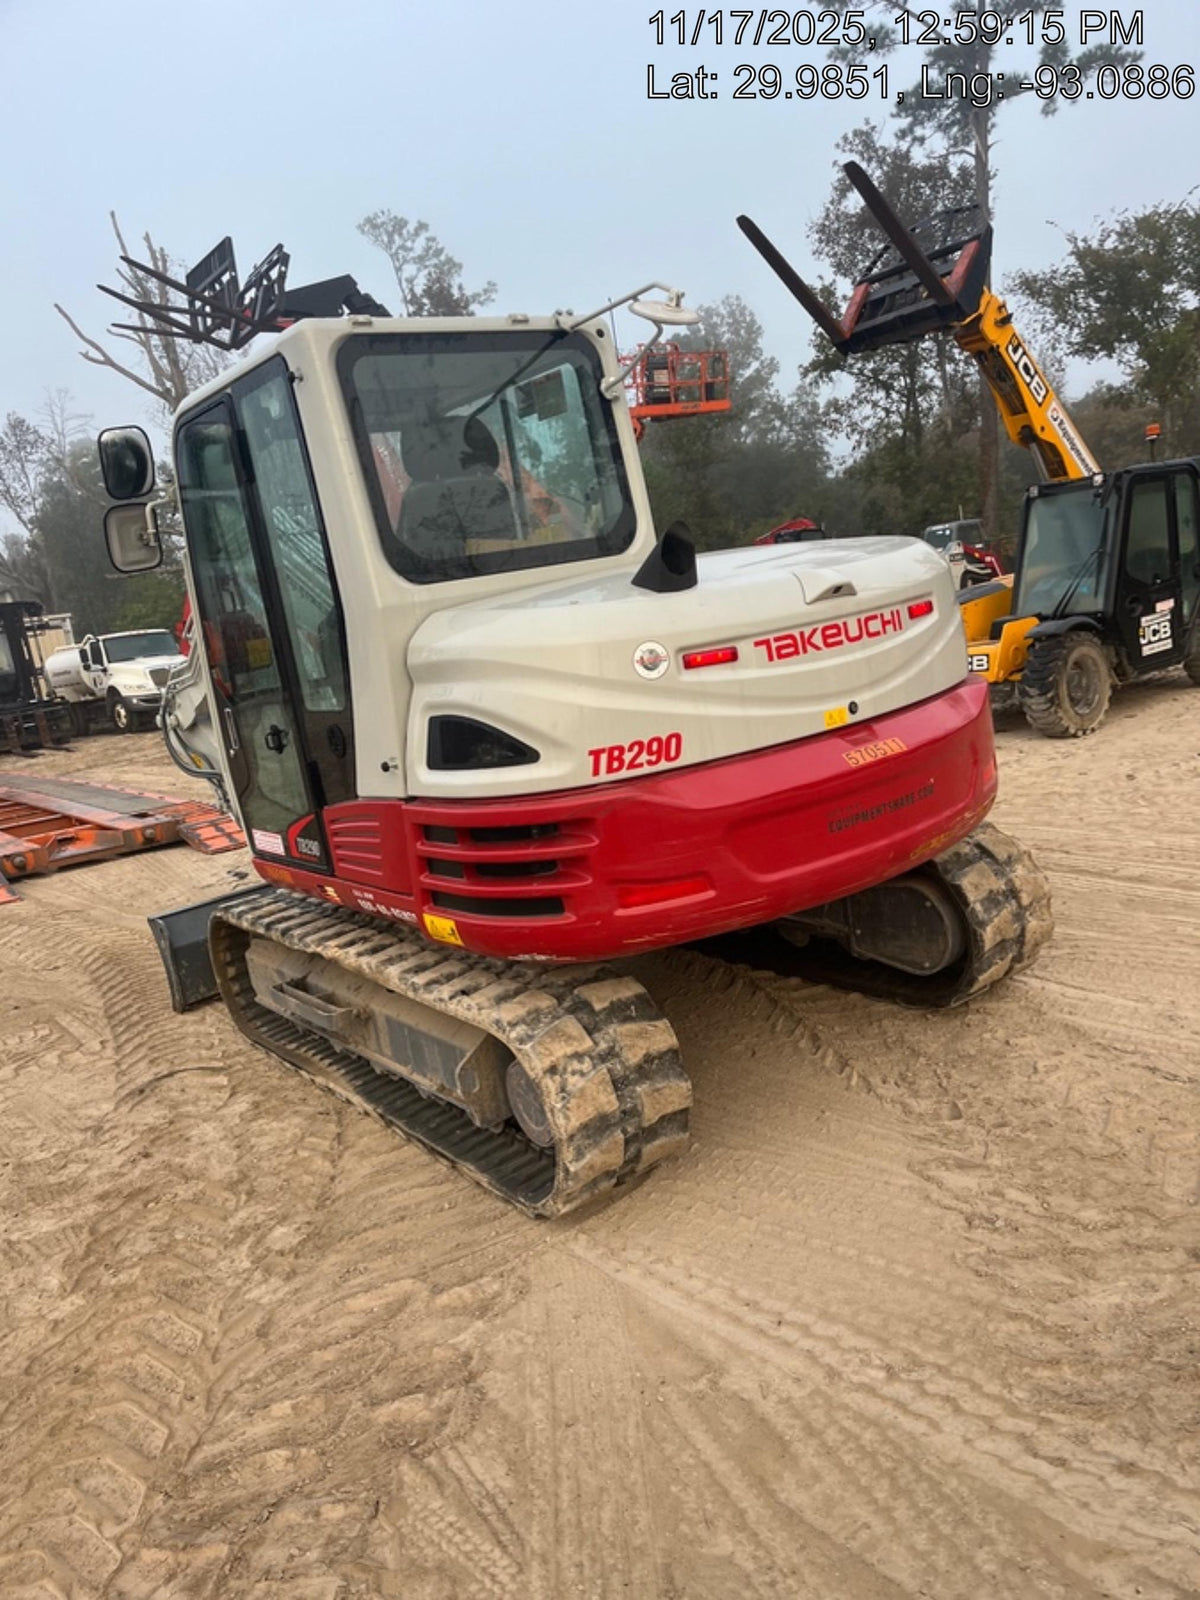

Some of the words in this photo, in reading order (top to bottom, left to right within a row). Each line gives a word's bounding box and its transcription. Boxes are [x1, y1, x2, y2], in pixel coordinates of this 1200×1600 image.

[1007, 343, 1047, 404] JCB
[753, 608, 903, 663] TAKEUCHI
[1139, 621, 1172, 645] JCB
[588, 731, 682, 777] TB290
[845, 738, 904, 766] 570511
